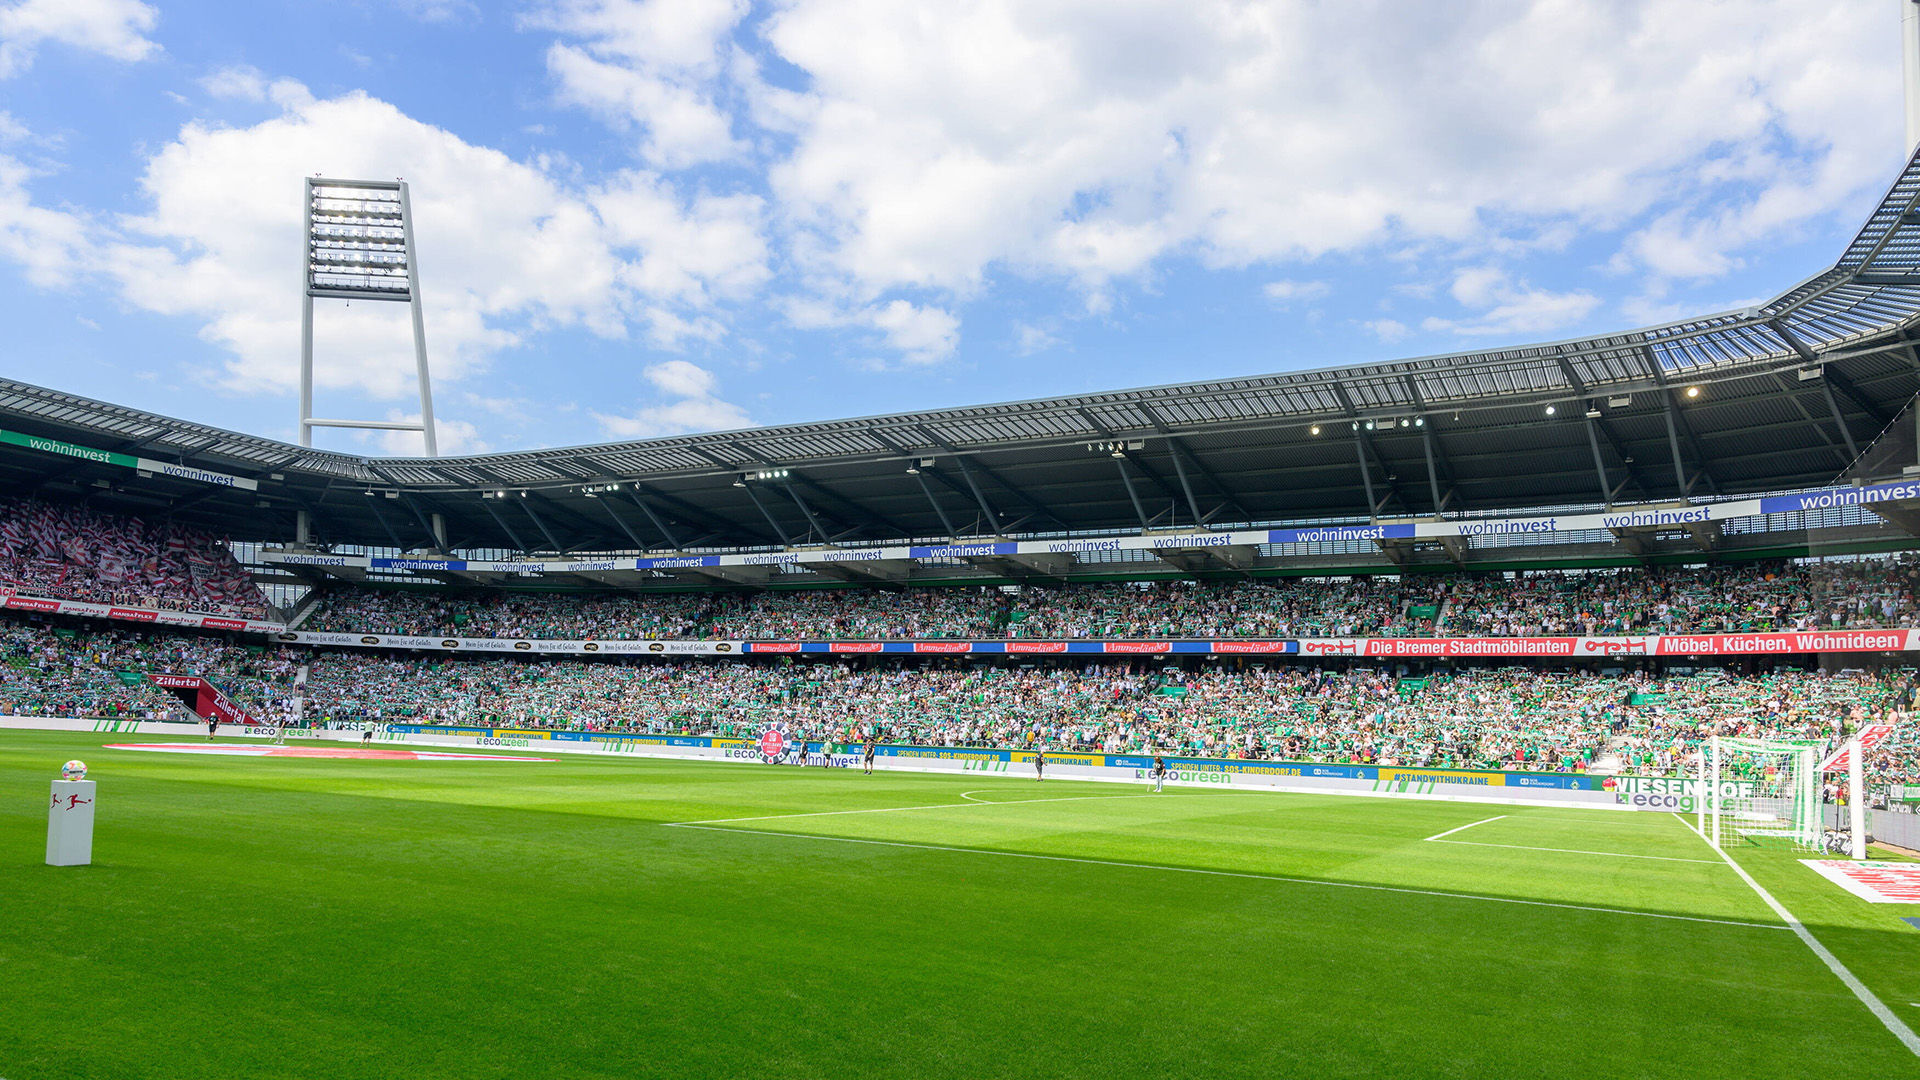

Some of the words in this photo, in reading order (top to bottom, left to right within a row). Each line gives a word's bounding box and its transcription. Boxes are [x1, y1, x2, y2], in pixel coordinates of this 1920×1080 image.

[30, 439, 111, 463] wohninvest
[1603, 507, 1710, 528] wohninvest
[1458, 518, 1557, 535] wohninvest
[1297, 526, 1385, 542] wohninvest
[1049, 539, 1120, 552] wohninvest
[1154, 534, 1231, 548] wohninvest
[823, 550, 882, 562] wohninvest
[930, 544, 995, 557] wohninvest
[283, 554, 345, 566] wohninvest
[652, 557, 703, 569] wohninvest
[743, 552, 799, 564] wohninvest
[391, 559, 449, 571] wohninvest
[493, 562, 545, 572] wohninvest
[567, 560, 615, 571] wohninvest
[1371, 641, 1393, 654] Die
[1396, 640, 1446, 654] Bremer
[1450, 640, 1569, 654] Stadtmöbilanten
[1664, 638, 1718, 654] Möbel,
[1723, 636, 1792, 653] Küchen,
[1796, 633, 1899, 650] Wohnideen
[155, 676, 200, 687] Zillertal
[213, 693, 246, 725] Zillertal
[253, 727, 313, 738] ecoreen
[790, 752, 859, 767] whninvest
[1022, 756, 1093, 766] #STDWITHUKRAINE
[1171, 762, 1199, 771] SPENDEN
[1393, 773, 1489, 785] #STANDWITHUKRAINE
[1633, 793, 1753, 813] ecogeen
